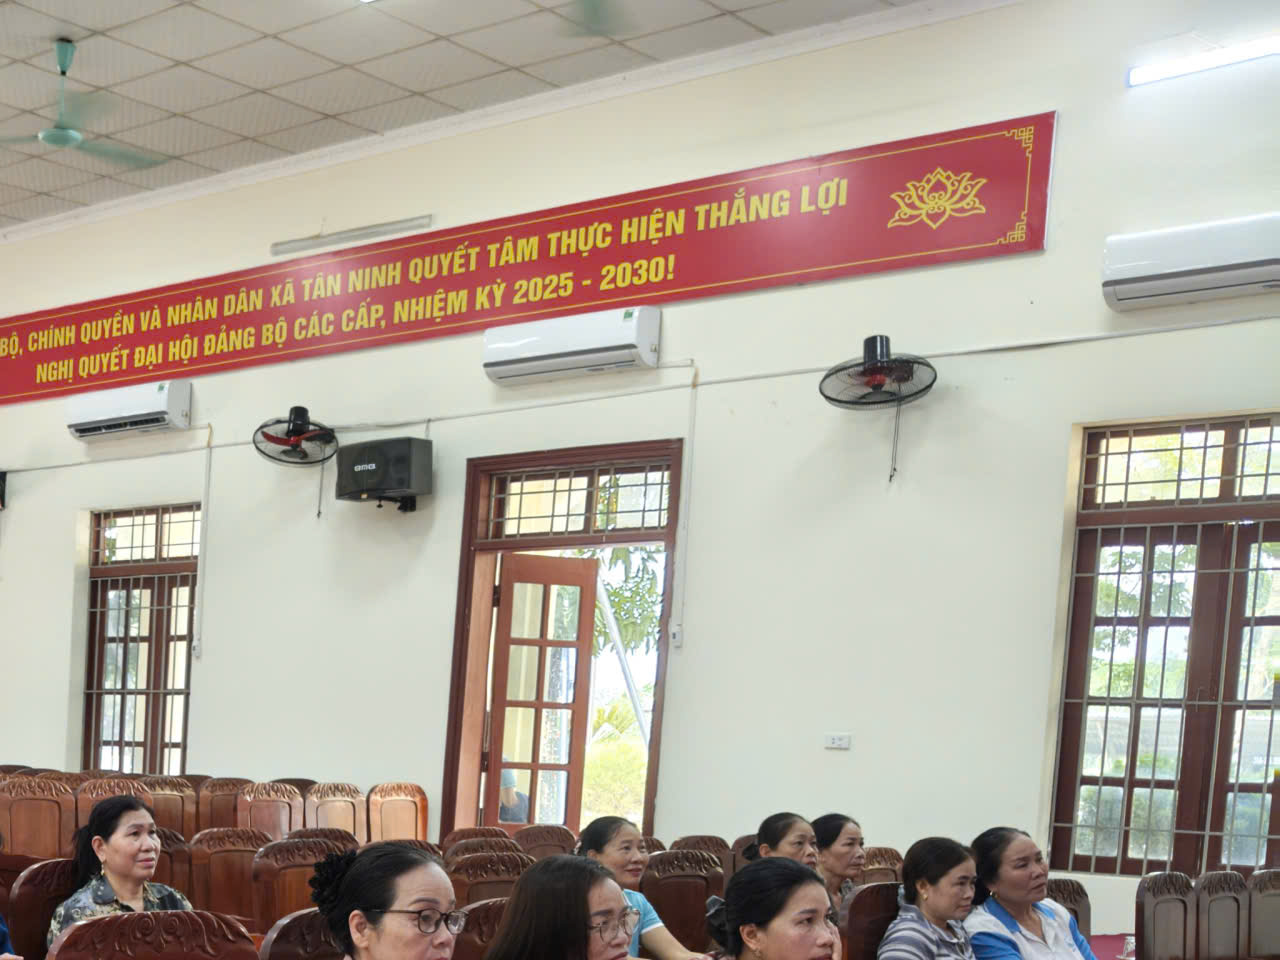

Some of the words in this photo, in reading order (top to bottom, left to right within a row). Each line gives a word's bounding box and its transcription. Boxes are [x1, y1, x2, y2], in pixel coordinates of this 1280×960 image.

[27, 322, 76, 353] CHÍNH
[80, 310, 135, 343] QUYỀN
[139, 306, 162, 332] VÀ
[166, 296, 217, 326] NHÂN
[223, 288, 263, 316] DÂN
[270, 278, 296, 308] XÃ
[302, 271, 342, 302] TÂN
[348, 261, 402, 294] NINH
[409, 242, 481, 283] QUYẾT
[487, 235, 540, 268] TÂM
[547, 220, 614, 258] THỰC
[621, 207, 685, 245] HIỆN
[695, 187, 790, 231] THẮNG
[800, 177, 849, 216] LỢI
[35, 360, 74, 385] NGHỊ
[78, 344, 130, 378] QUYẾT
[133, 346, 163, 370] ĐẠI
[168, 335, 199, 365] HỘI
[203, 324, 256, 357] ĐẢNG
[261, 317, 288, 348] BỘ
[294, 309, 334, 340] CÁC
[342, 297, 386, 333] CẤP,
[392, 288, 469, 325] NHIỆM
[475, 276, 508, 310] KỲ
[512, 272, 575, 305] 2025
[599, 253, 677, 292] 2030!
